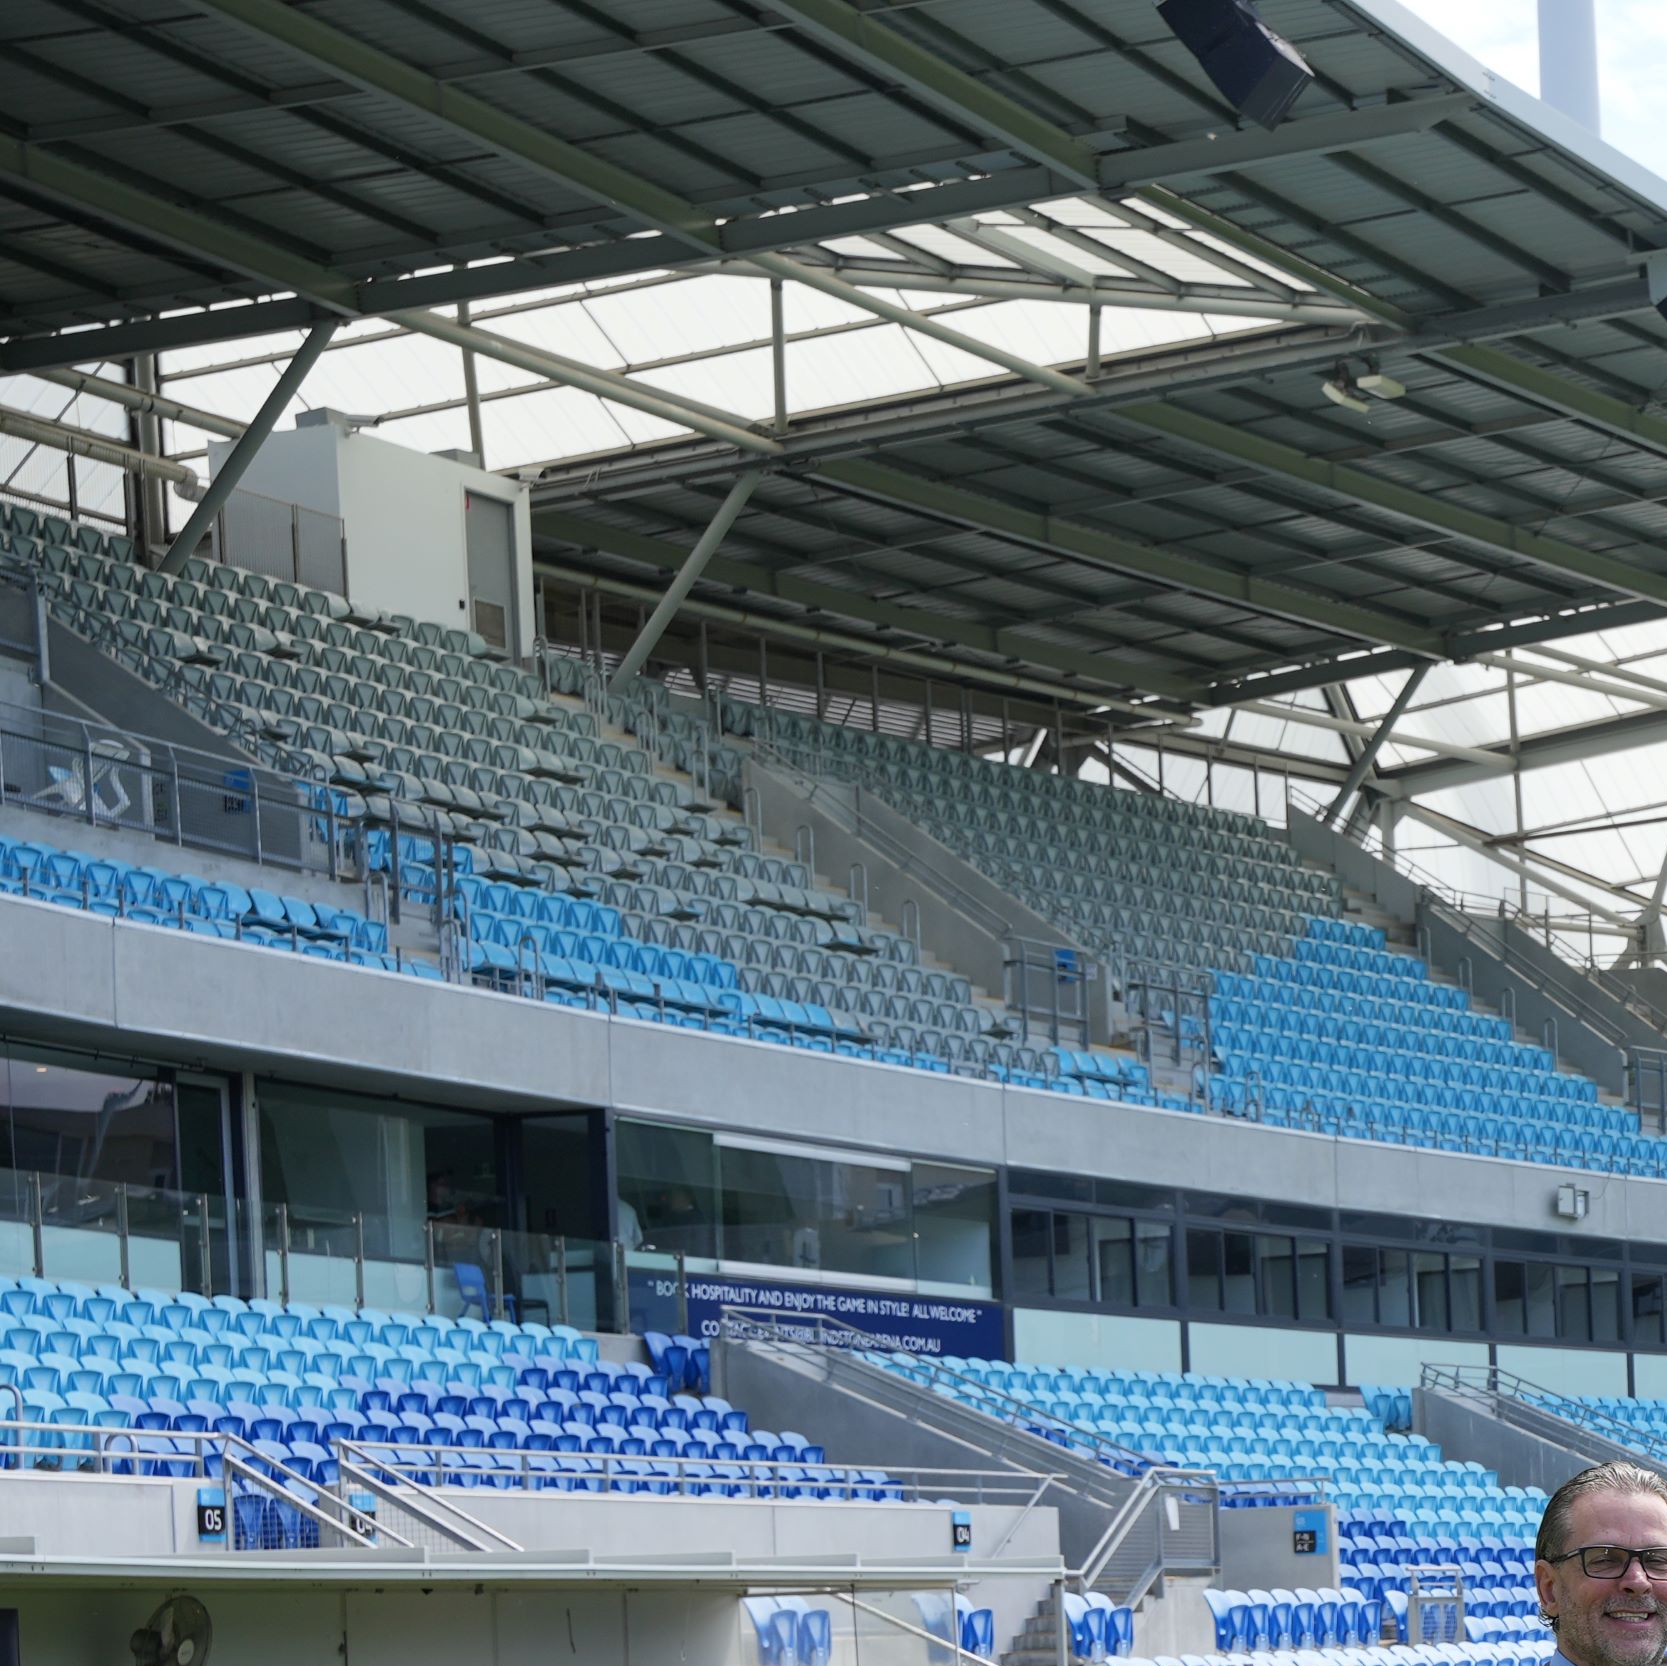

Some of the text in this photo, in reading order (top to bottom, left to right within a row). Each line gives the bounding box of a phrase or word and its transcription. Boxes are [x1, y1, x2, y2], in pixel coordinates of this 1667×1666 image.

[691, 1285, 757, 1305] HOSPITALITY
[757, 1290, 783, 1307] AND
[784, 1292, 816, 1311] ENJOY
[816, 1294, 836, 1311] THE
[837, 1296, 866, 1313] GAME
[867, 1299, 878, 1314] IN
[912, 1304, 930, 1319] ALL
[205, 1509, 222, 1530] 05
